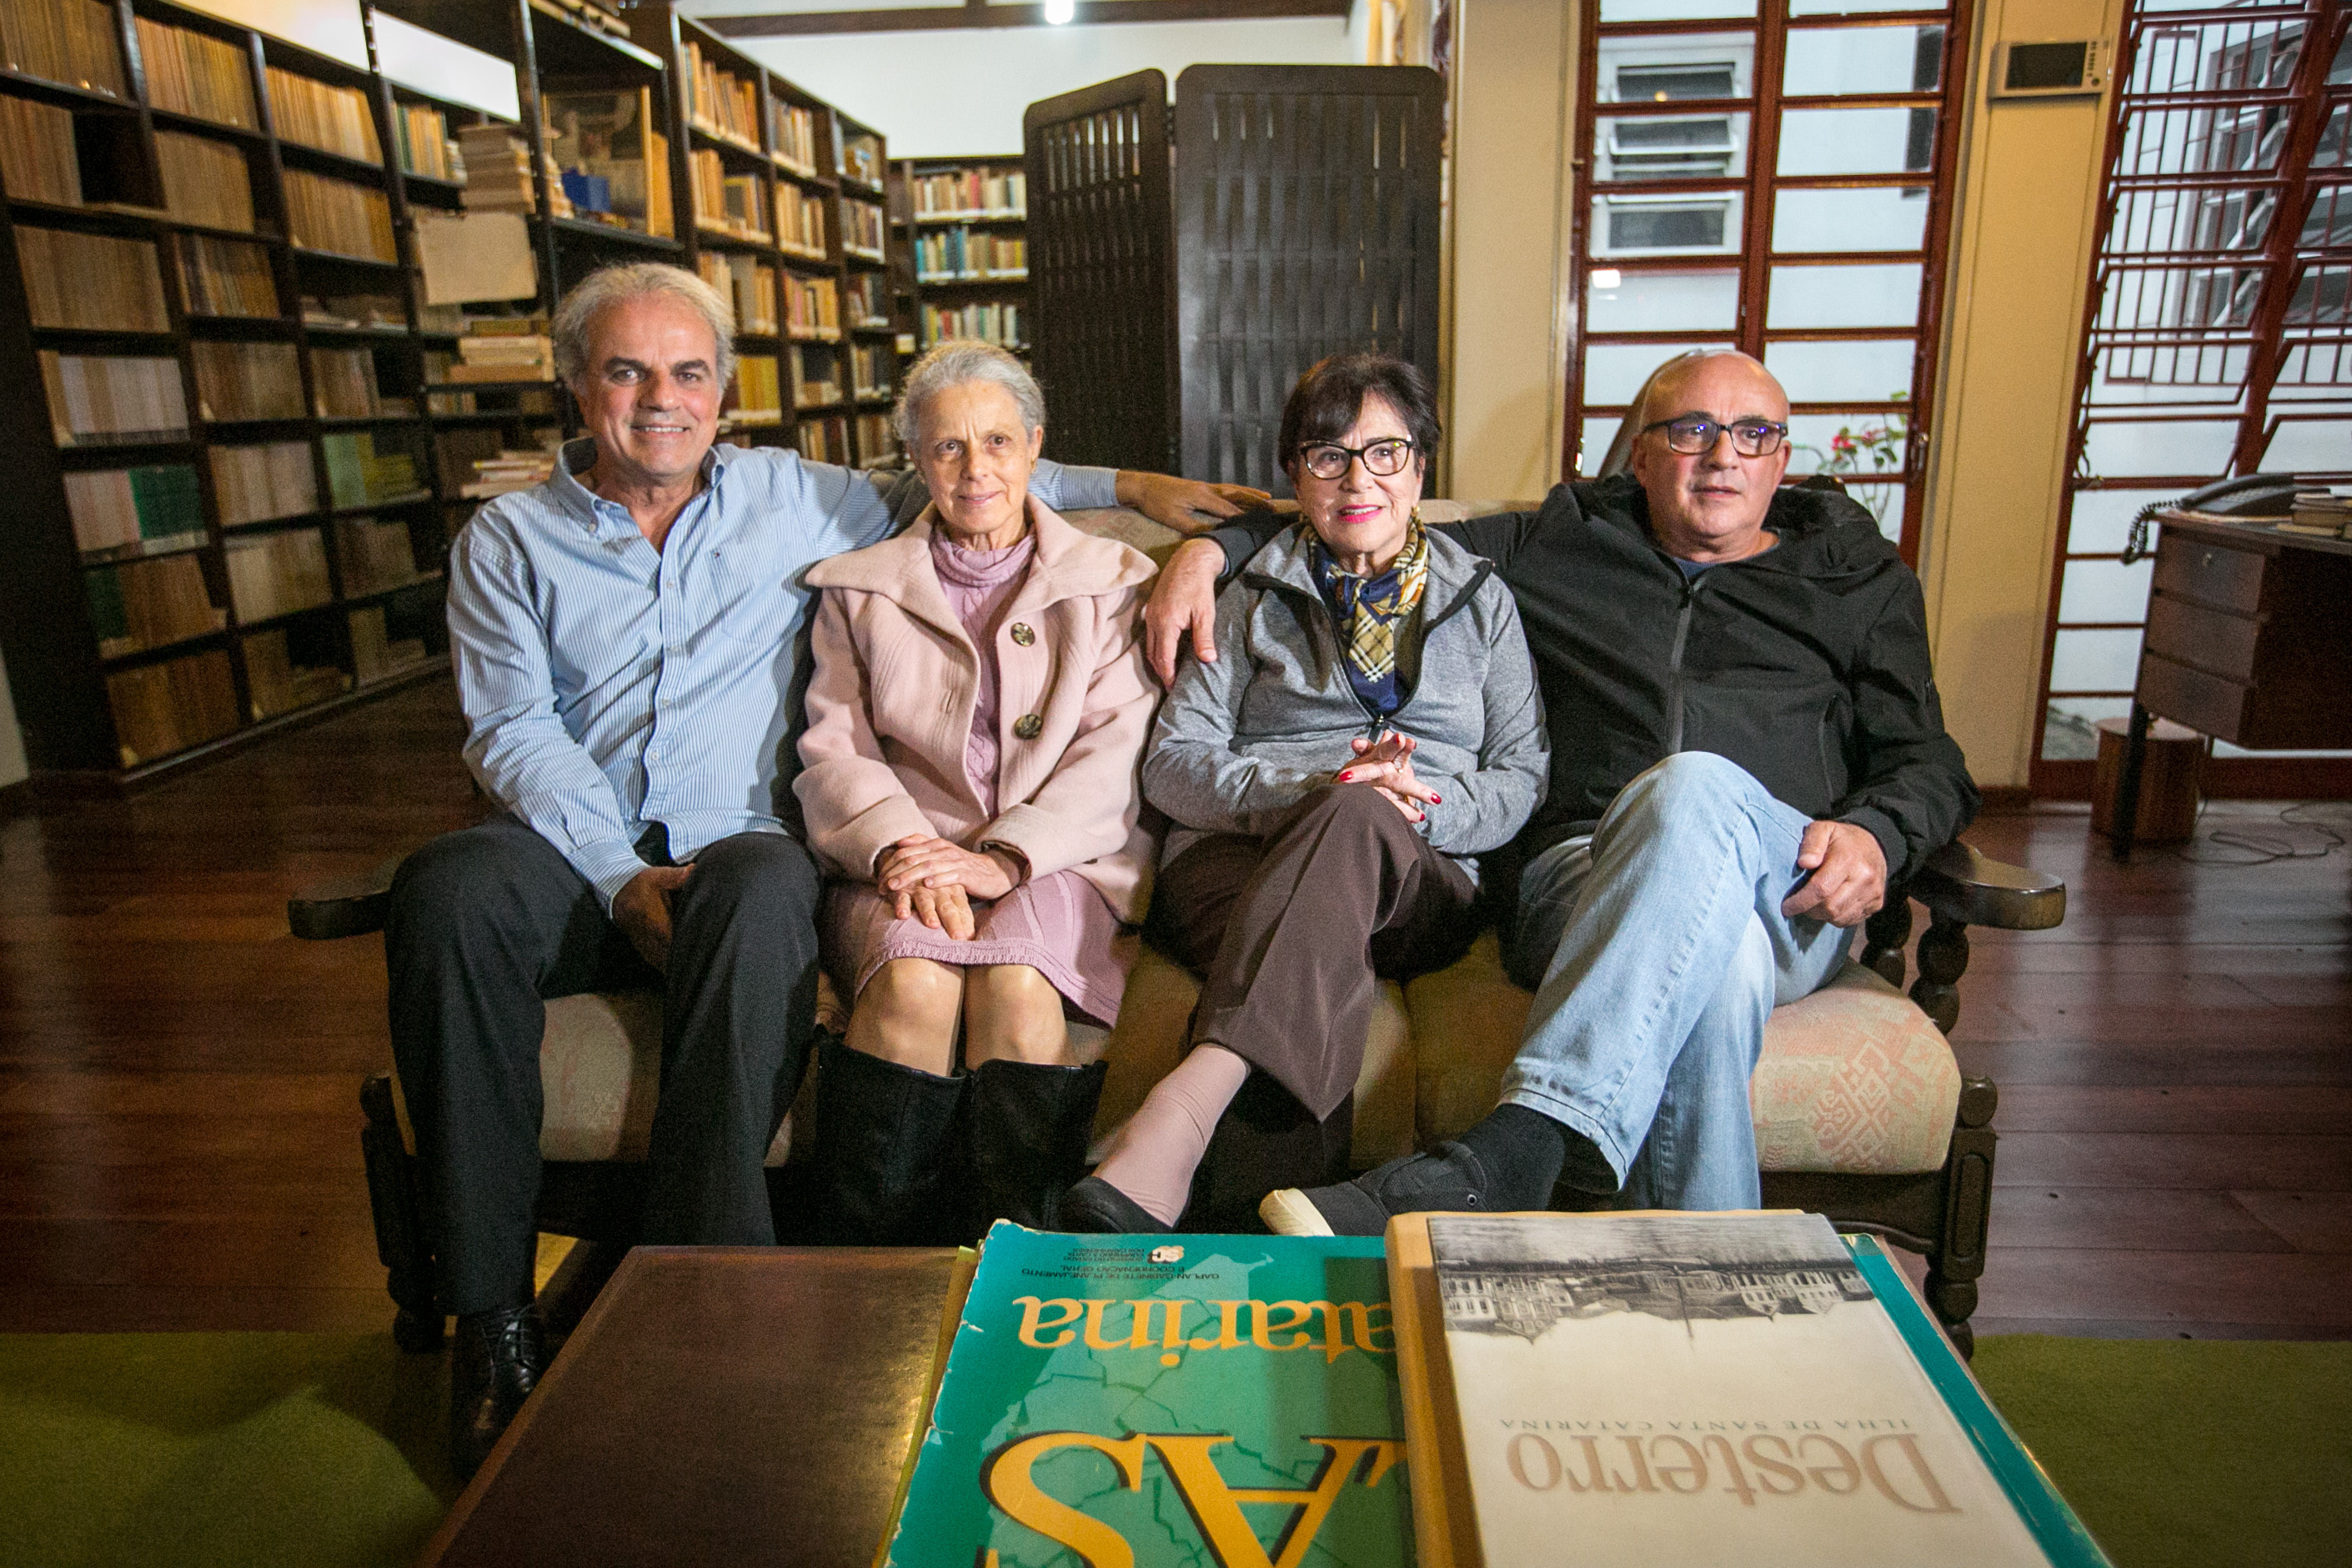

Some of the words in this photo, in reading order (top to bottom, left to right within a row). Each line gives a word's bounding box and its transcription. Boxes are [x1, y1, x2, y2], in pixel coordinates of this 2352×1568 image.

[1021, 1268, 1105, 1280] PLANEJAMENTO
[1013, 1295, 1397, 1366] atarina
[1500, 1419, 1653, 1431] CATARINA
[1667, 1420, 1768, 1431] SANTA
[1783, 1420, 1822, 1431] DE
[1834, 1419, 1910, 1430] ILHA
[1506, 1432, 1963, 1515] Desterro
